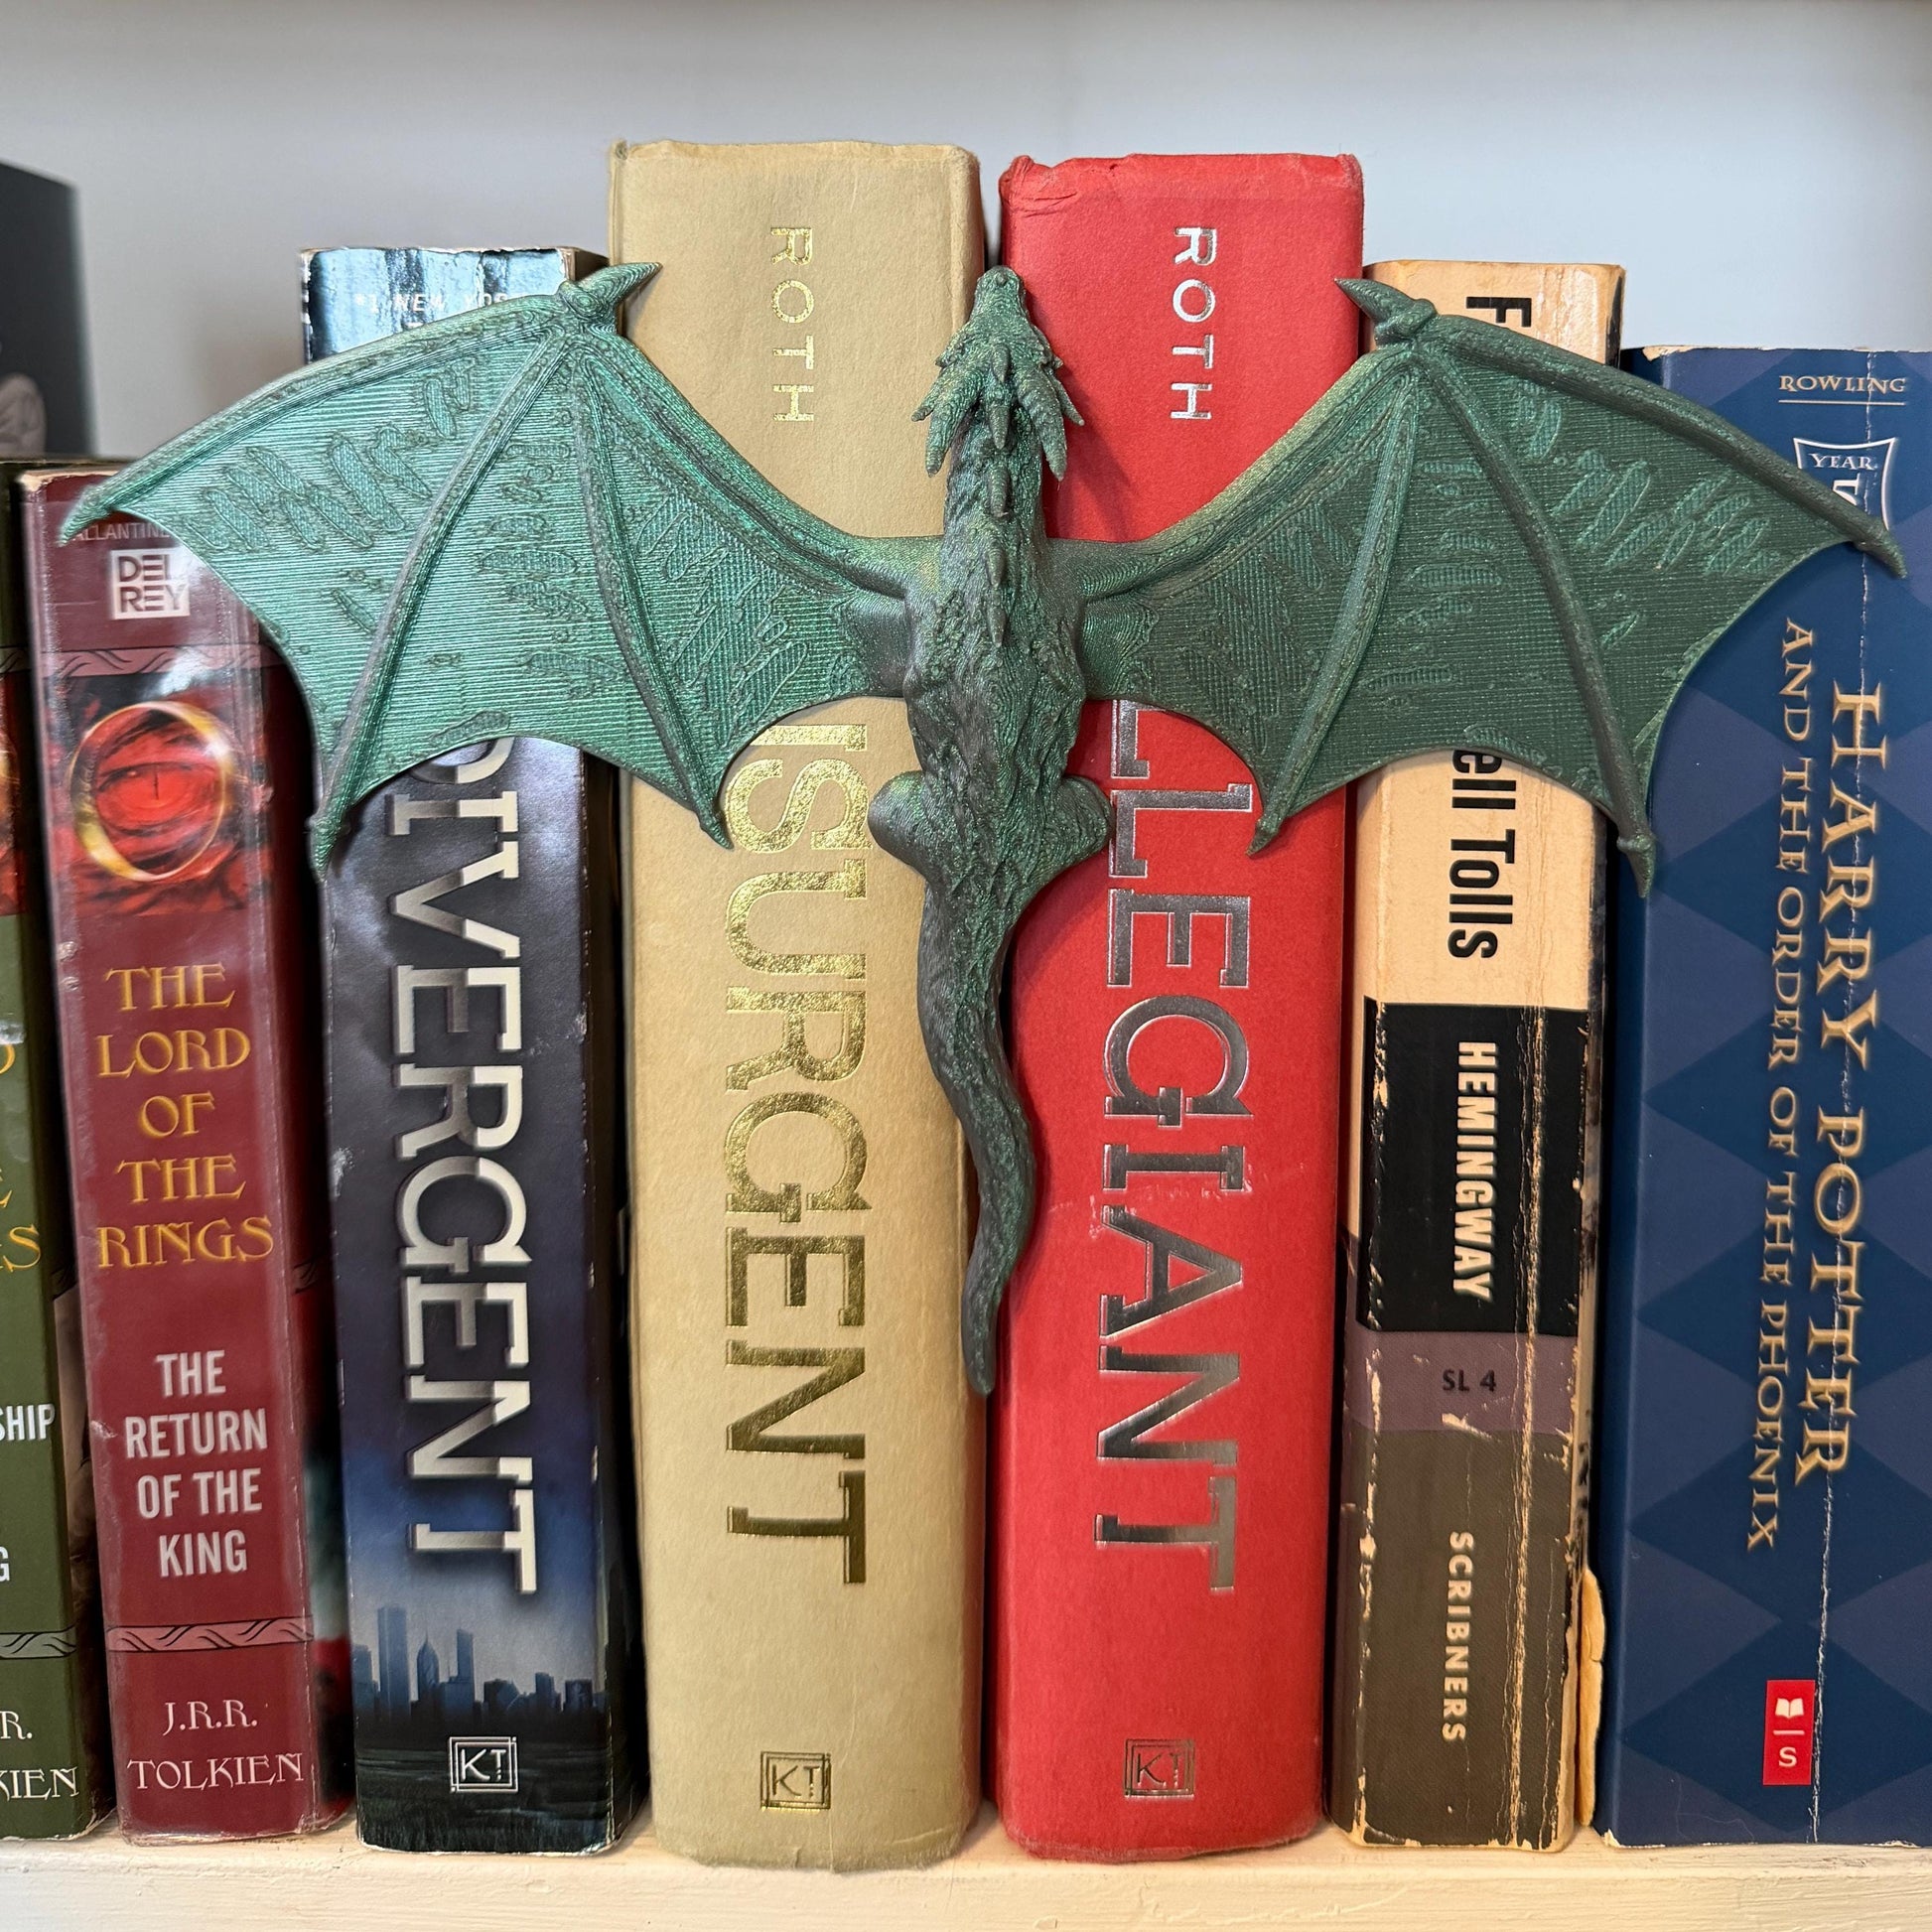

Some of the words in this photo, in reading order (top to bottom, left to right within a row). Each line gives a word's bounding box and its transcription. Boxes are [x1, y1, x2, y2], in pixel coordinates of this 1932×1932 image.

[770, 226, 815, 423] ROTH
[1171, 226, 1218, 422] ROTH
[1779, 375, 1906, 394] ROWLING
[1809, 453, 1875, 470] YEAR
[119, 584, 188, 614] REY
[1779, 618, 1814, 743] AND
[1451, 750, 1517, 810] ell
[1776, 757, 1812, 876] THE
[1447, 828, 1516, 960] Tolls
[1816, 678, 1887, 1071] HARRY
[105, 962, 235, 1011] THE
[1767, 886, 1804, 1071] ORDER
[96, 1028, 251, 1079] LORD
[139, 1091, 215, 1139] OF
[1768, 1086, 1799, 1159] OF
[115, 1154, 247, 1203] THE
[1452, 1041, 1499, 1304] HEMINGWAY
[97, 1216, 275, 1269] RINGS
[1760, 1172, 1796, 1288] THE
[1794, 1105, 1866, 1486] POTTER
[156, 1349, 227, 1398] THE
[1443, 1369, 1470, 1392] SL
[1479, 1369, 1497, 1393] 4
[124, 1408, 268, 1459] RETURN
[1747, 1299, 1790, 1552] PHOENIX
[137, 1473, 182, 1520] OF
[193, 1467, 263, 1515] THE
[159, 1529, 248, 1578] KING
[1442, 1530, 1474, 1742] SCRIBNERS
[163, 1699, 258, 1736] J.R.R.
[126, 1751, 305, 1791] TOLKIEN
[1778, 1745, 1798, 1767] S
